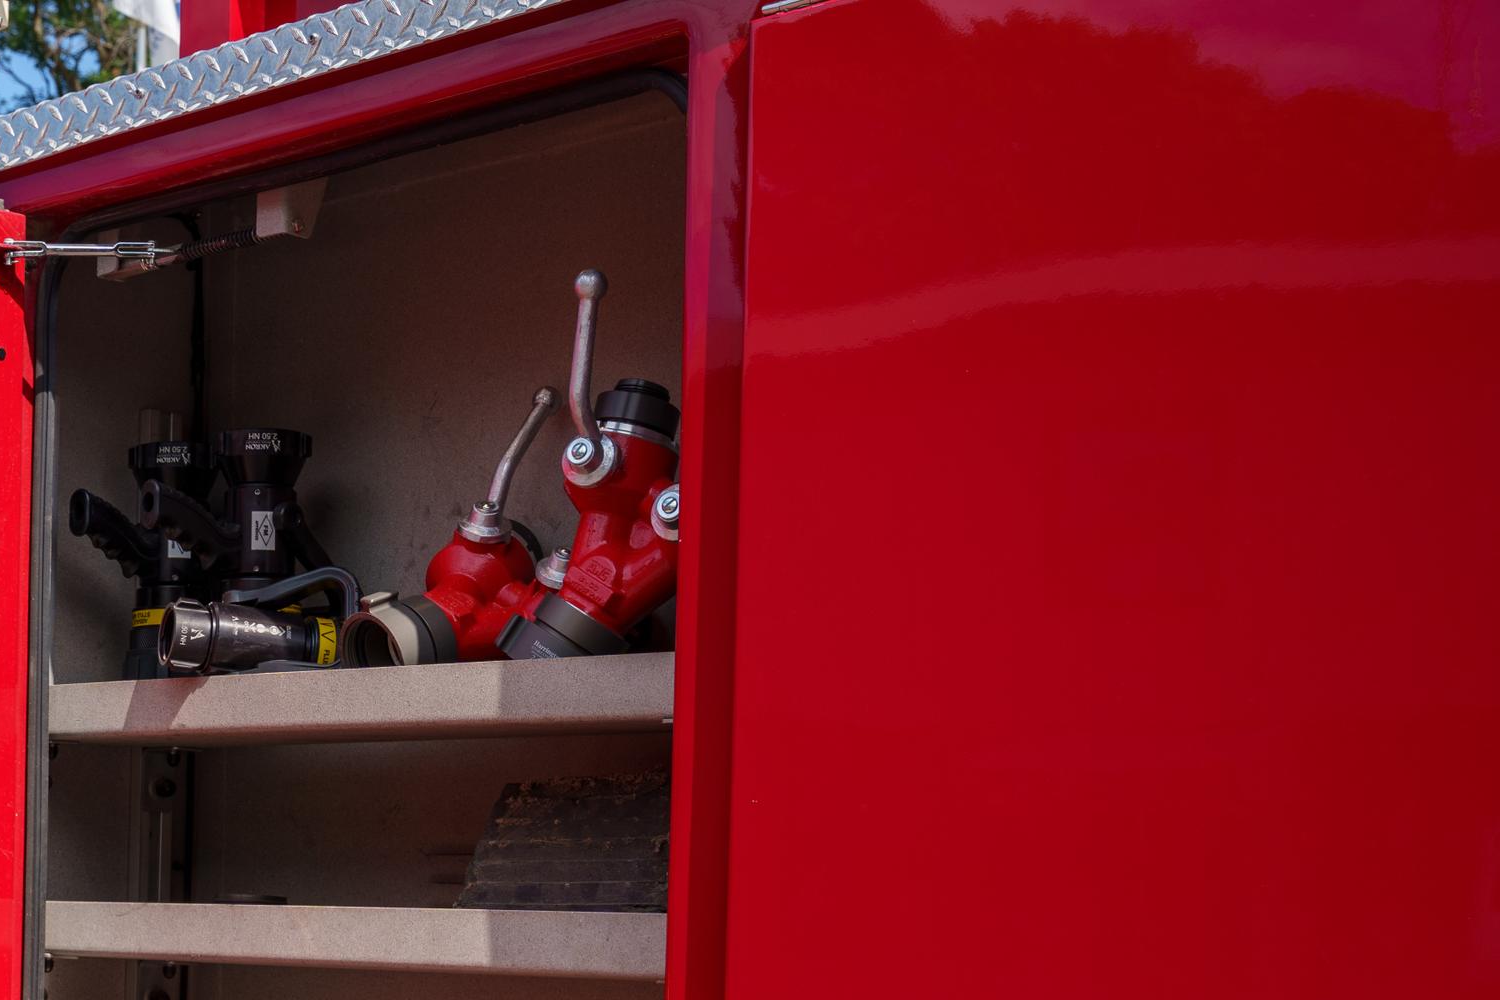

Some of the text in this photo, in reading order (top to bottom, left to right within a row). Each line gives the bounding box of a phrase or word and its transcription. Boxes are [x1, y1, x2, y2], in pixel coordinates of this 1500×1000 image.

[248, 432, 260, 440] NH
[159, 446, 171, 454] NH
[245, 443, 270, 451] AKRON
